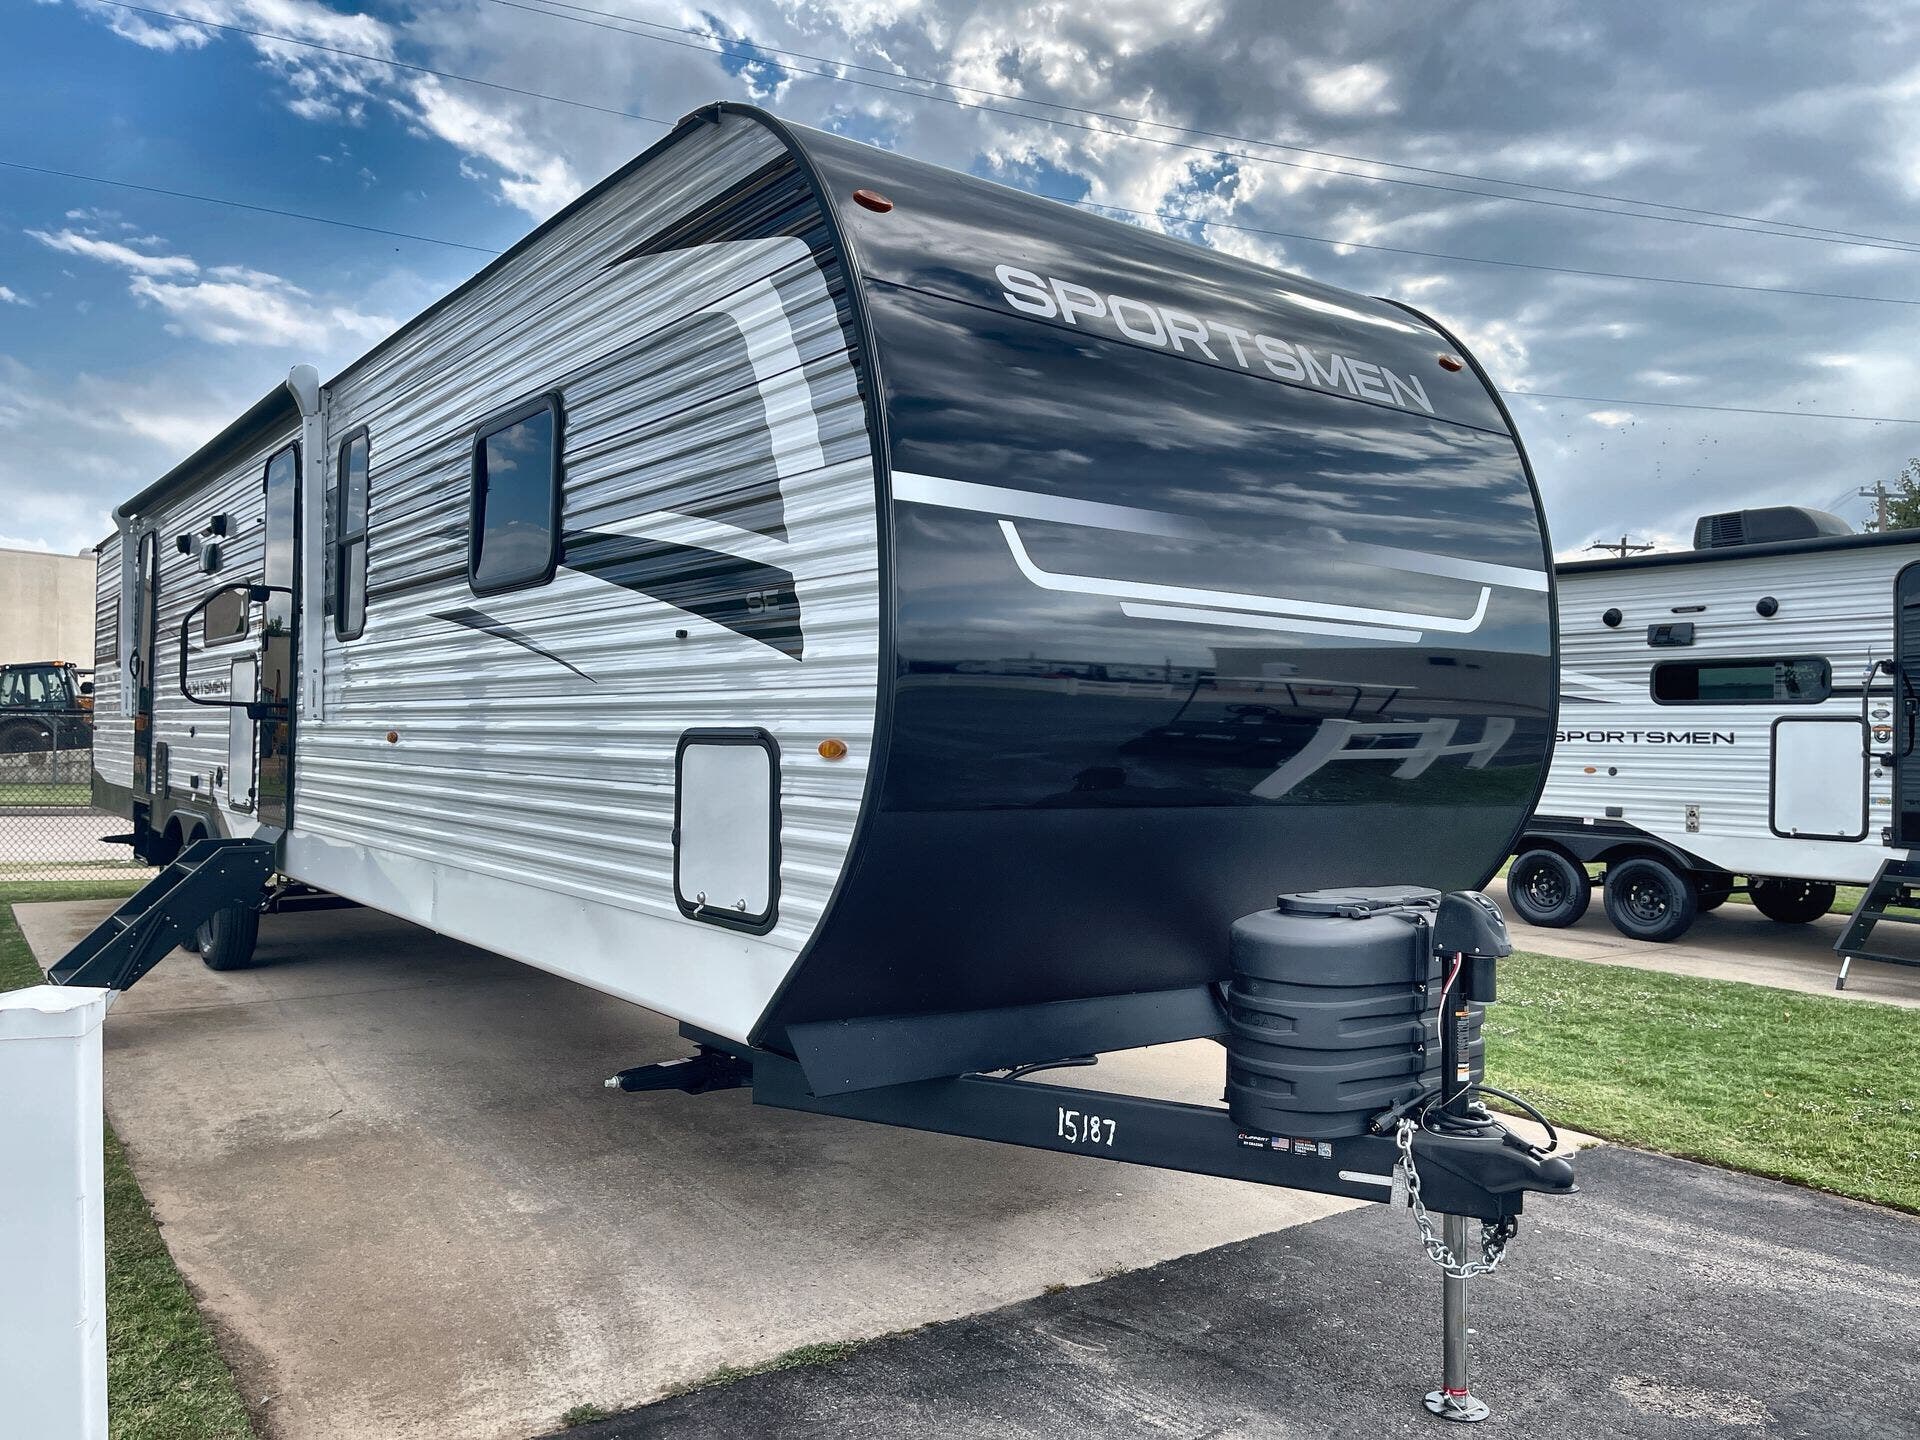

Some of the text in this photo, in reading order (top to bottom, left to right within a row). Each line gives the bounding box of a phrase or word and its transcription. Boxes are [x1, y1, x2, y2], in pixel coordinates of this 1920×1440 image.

[995, 264, 1435, 414] SPORTSMEN
[745, 589, 780, 615] SE
[1555, 731, 1735, 745] SPORTSMEN
[1058, 1106, 1117, 1147] 15187
